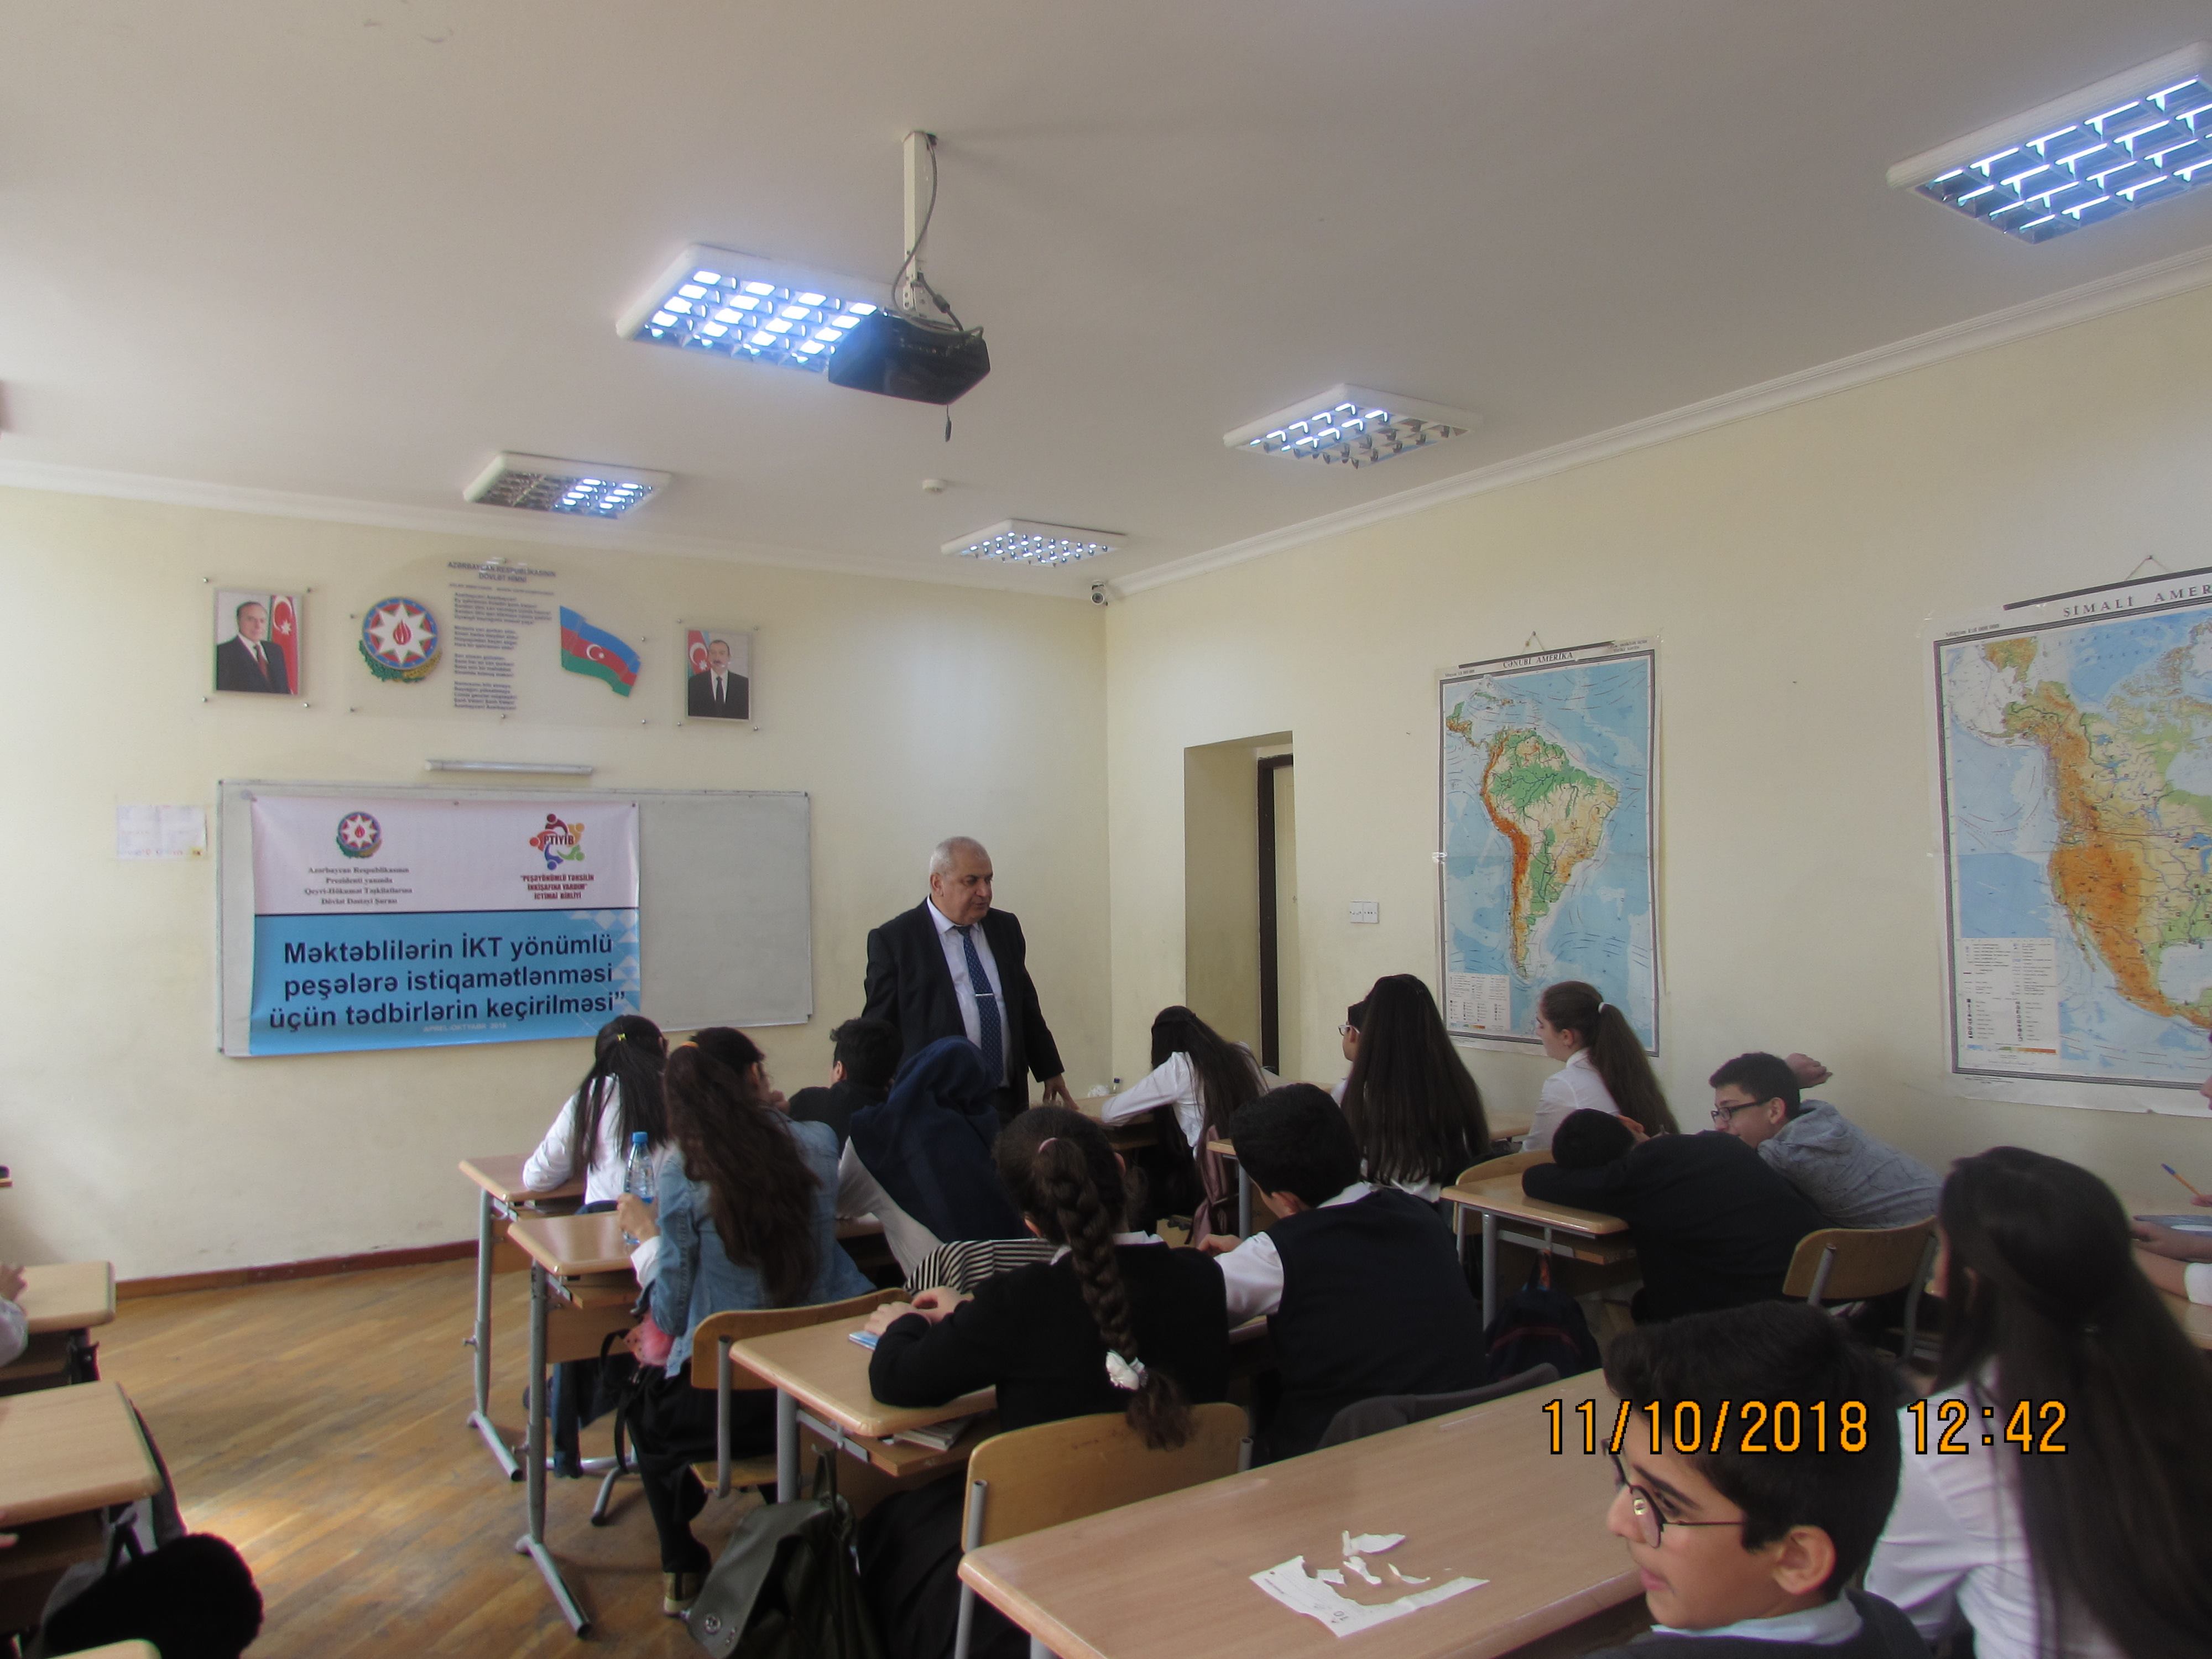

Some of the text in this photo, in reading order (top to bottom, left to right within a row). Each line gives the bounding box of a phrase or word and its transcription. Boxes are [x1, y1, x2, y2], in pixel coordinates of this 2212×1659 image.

[284, 932, 612, 964] Məktəblilərin İKT yönümlü
[285, 962, 613, 1002] peşələrə istiqamətlənməsi
[270, 1006, 336, 1033] üçün
[346, 999, 478, 1025] tədbirlərin
